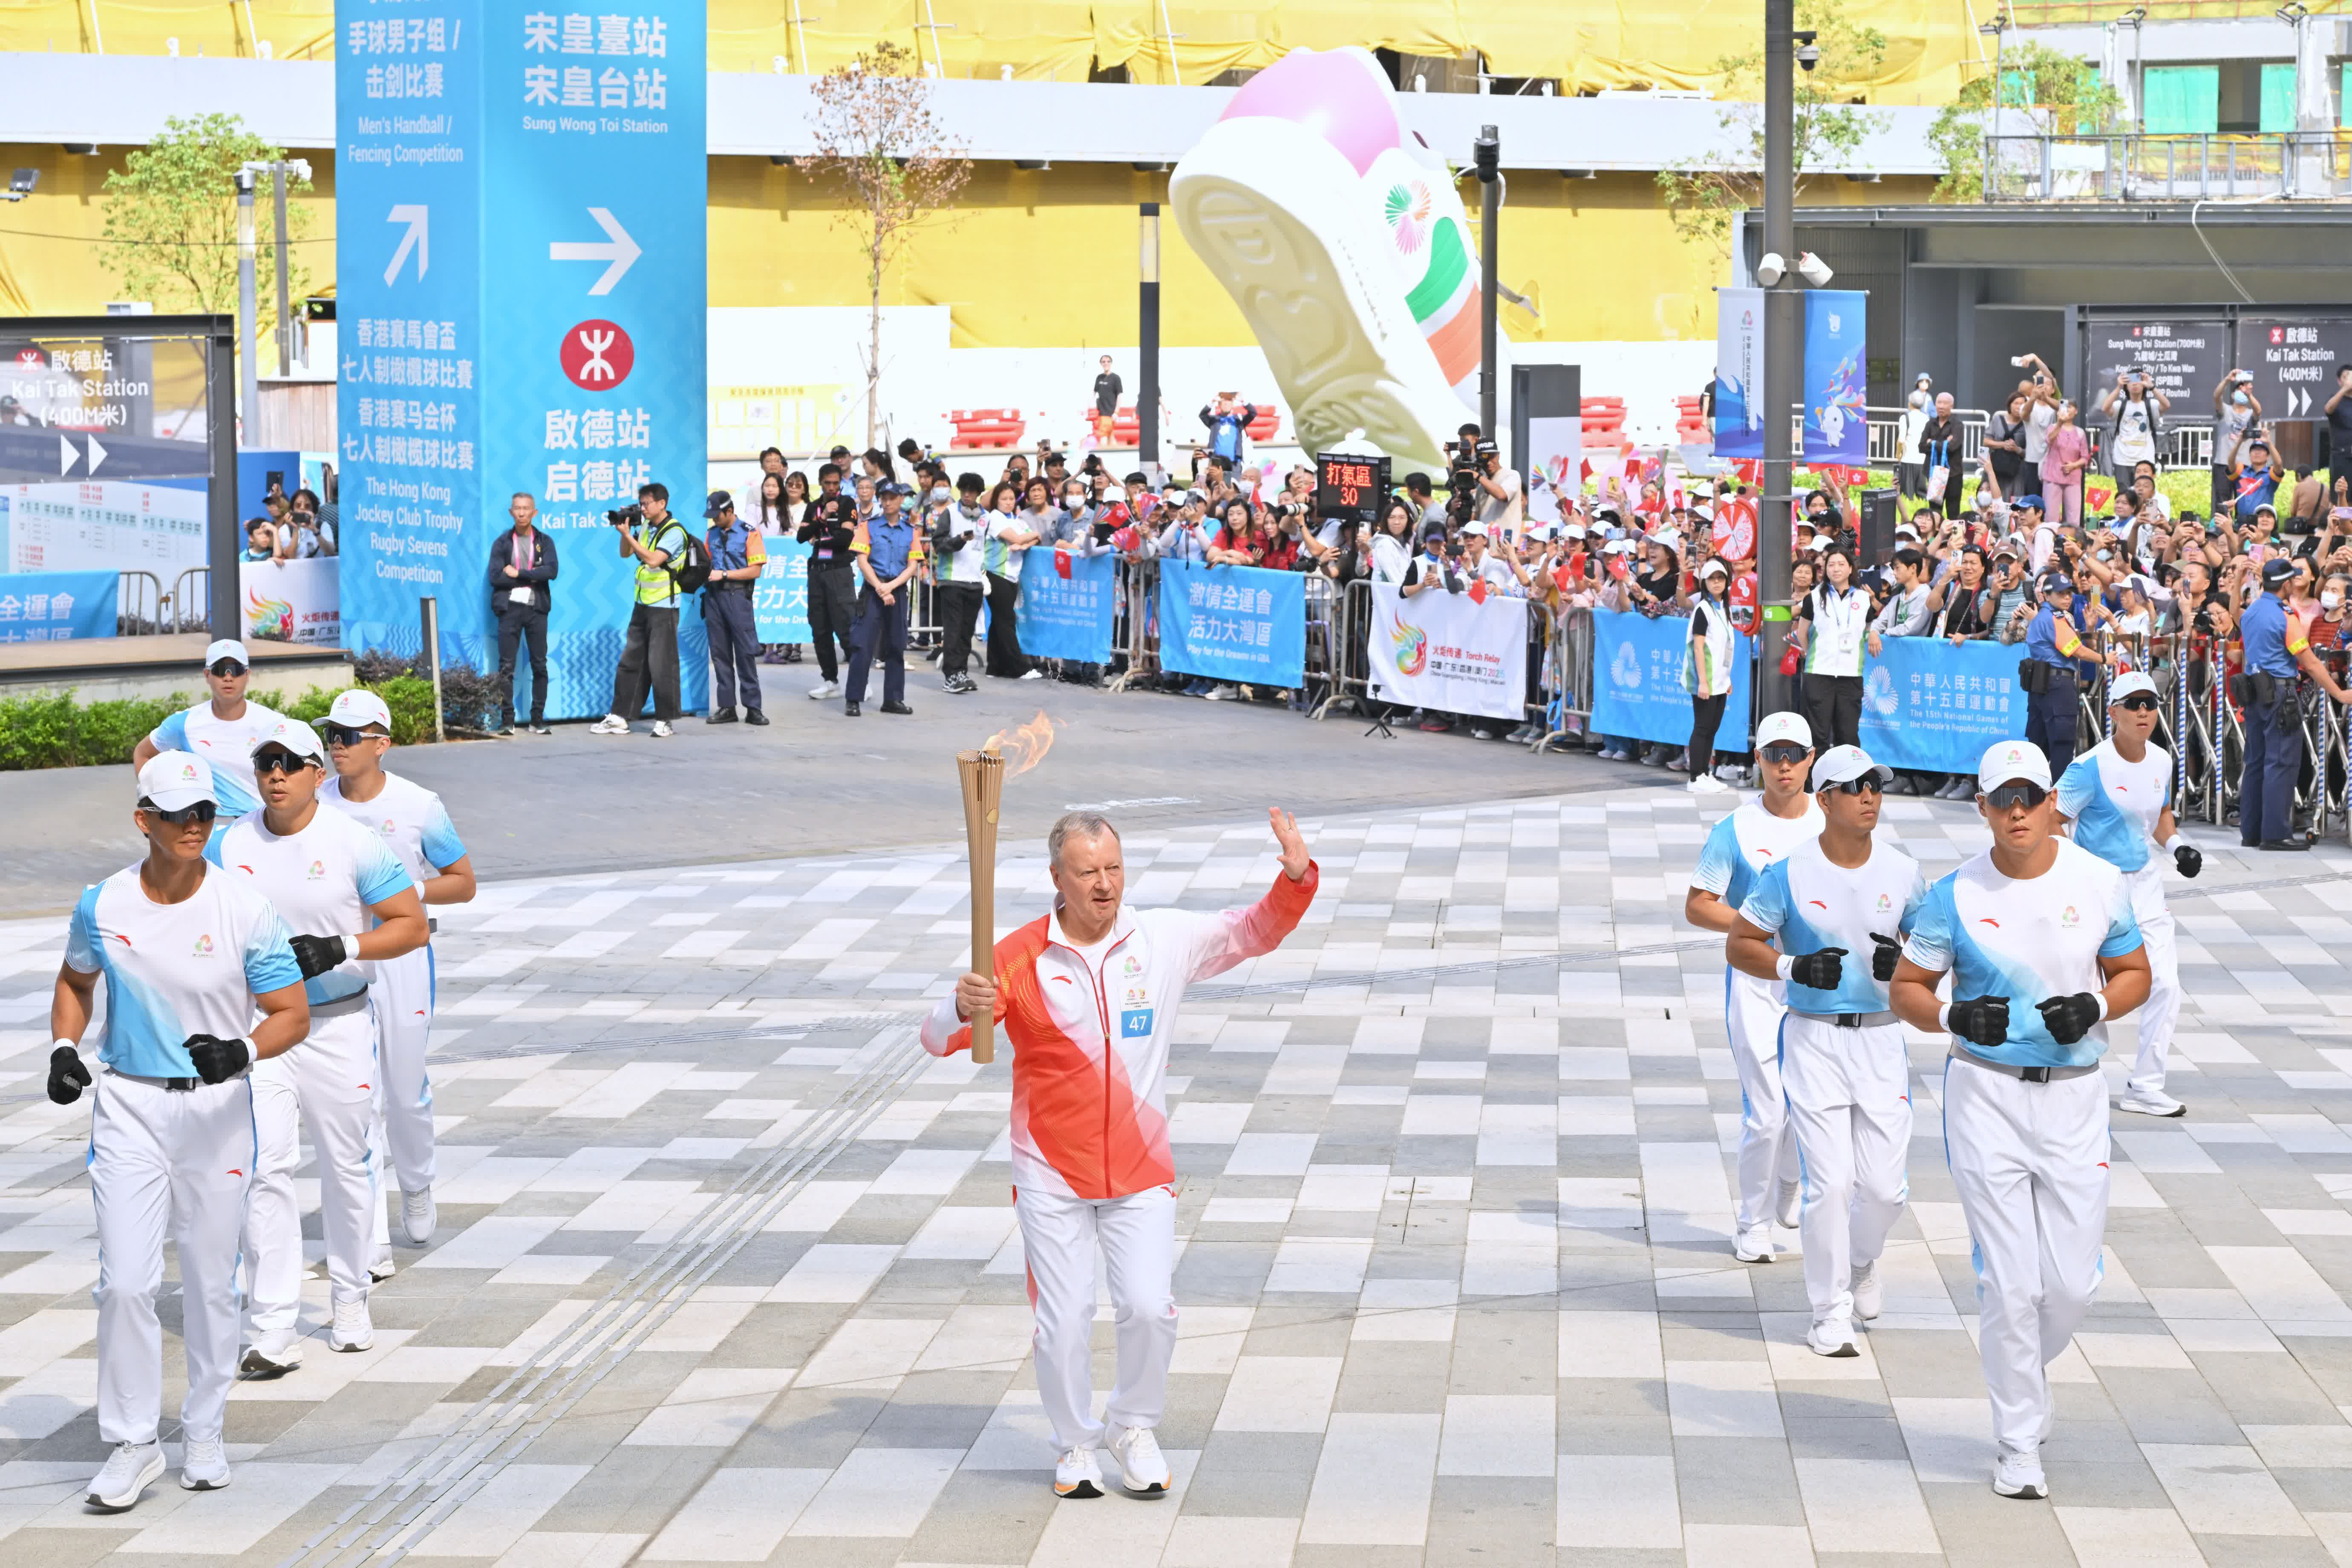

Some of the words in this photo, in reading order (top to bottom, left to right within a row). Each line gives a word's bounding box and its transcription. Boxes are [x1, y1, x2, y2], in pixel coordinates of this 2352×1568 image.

[348, 18, 445, 55] 手球男子组
[523, 12, 667, 58] 宋皇臺站
[366, 63, 444, 99] 击剑比赛
[523, 64, 667, 110] 宋皇台站
[358, 115, 391, 135] Men's
[394, 114, 444, 135] Handball
[523, 116, 556, 134] Sung
[559, 117, 596, 135] Wong
[600, 118, 619, 133] Toi
[623, 118, 668, 133] Station
[348, 144, 391, 167] Fencing
[395, 144, 463, 167] Competition
[357, 318, 456, 351] 香港賽馬會盃
[2108, 340, 2124, 350] Sung
[2125, 340, 2142, 350] Wong
[2143, 340, 2152, 348] Toi
[2154, 340, 2176, 348] Station
[51, 349, 112, 372] 啟德站
[2266, 348, 2281, 362] Kai
[2283, 348, 2300, 362] Tak
[2301, 347, 2335, 361] Station
[342, 355, 473, 389] 七人制橄欖球比賽
[2143, 364, 2154, 374] City
[2160, 364, 2167, 372] To
[2168, 364, 2180, 372] Kwa
[2182, 364, 2195, 372] Wan
[2279, 366, 2323, 383] (400M米)
[12, 380, 40, 399] Kai
[45, 380, 79, 398] Tak
[83, 378, 149, 398] Station
[40, 404, 127, 427] (400M米)
[358, 398, 457, 432] 香港赛马会杯
[544, 407, 651, 450] 啟德站
[342, 434, 474, 471] 七人制橄榄球比赛
[544, 458, 651, 502] 启德站
[1326, 462, 1372, 487] 打氣區
[366, 477, 386, 496] The
[389, 478, 419, 503] Hong
[422, 481, 450, 505] Kong
[1340, 487, 1358, 506] 30
[355, 504, 394, 530] Jockey
[397, 505, 421, 526] Club
[424, 510, 463, 535] Trophy
[541, 511, 566, 530] Kai
[569, 511, 597, 529] Tak
[370, 532, 404, 557] Rugby
[408, 536, 448, 557] Sevens
[376, 561, 443, 585] Competition
[1189, 581, 1273, 615] 激情全運會
[759, 614, 772, 624] for
[775, 615, 790, 624] the
[1188, 614, 1273, 647] 活力大灣區
[1187, 644, 1202, 656] Play
[1203, 646, 1213, 655] for
[1214, 648, 1225, 657] the
[1466, 651, 1482, 662] Torch
[1484, 654, 1501, 665] Relay
[1911, 672, 2011, 694] 中華人民共和國
[1910, 690, 2009, 712] 第十五屆運動會
[1910, 709, 1923, 717] The
[1925, 710, 1941, 719] 15th
[1944, 712, 1974, 721] National
[1977, 715, 1998, 723] Games
[2001, 716, 2009, 724] of
[1923, 722, 1950, 731] People's
[1952, 724, 1980, 734] Republic
[1981, 726, 1988, 734] of
[1989, 726, 2009, 736] China
[1129, 1015, 1147, 1031] 47
